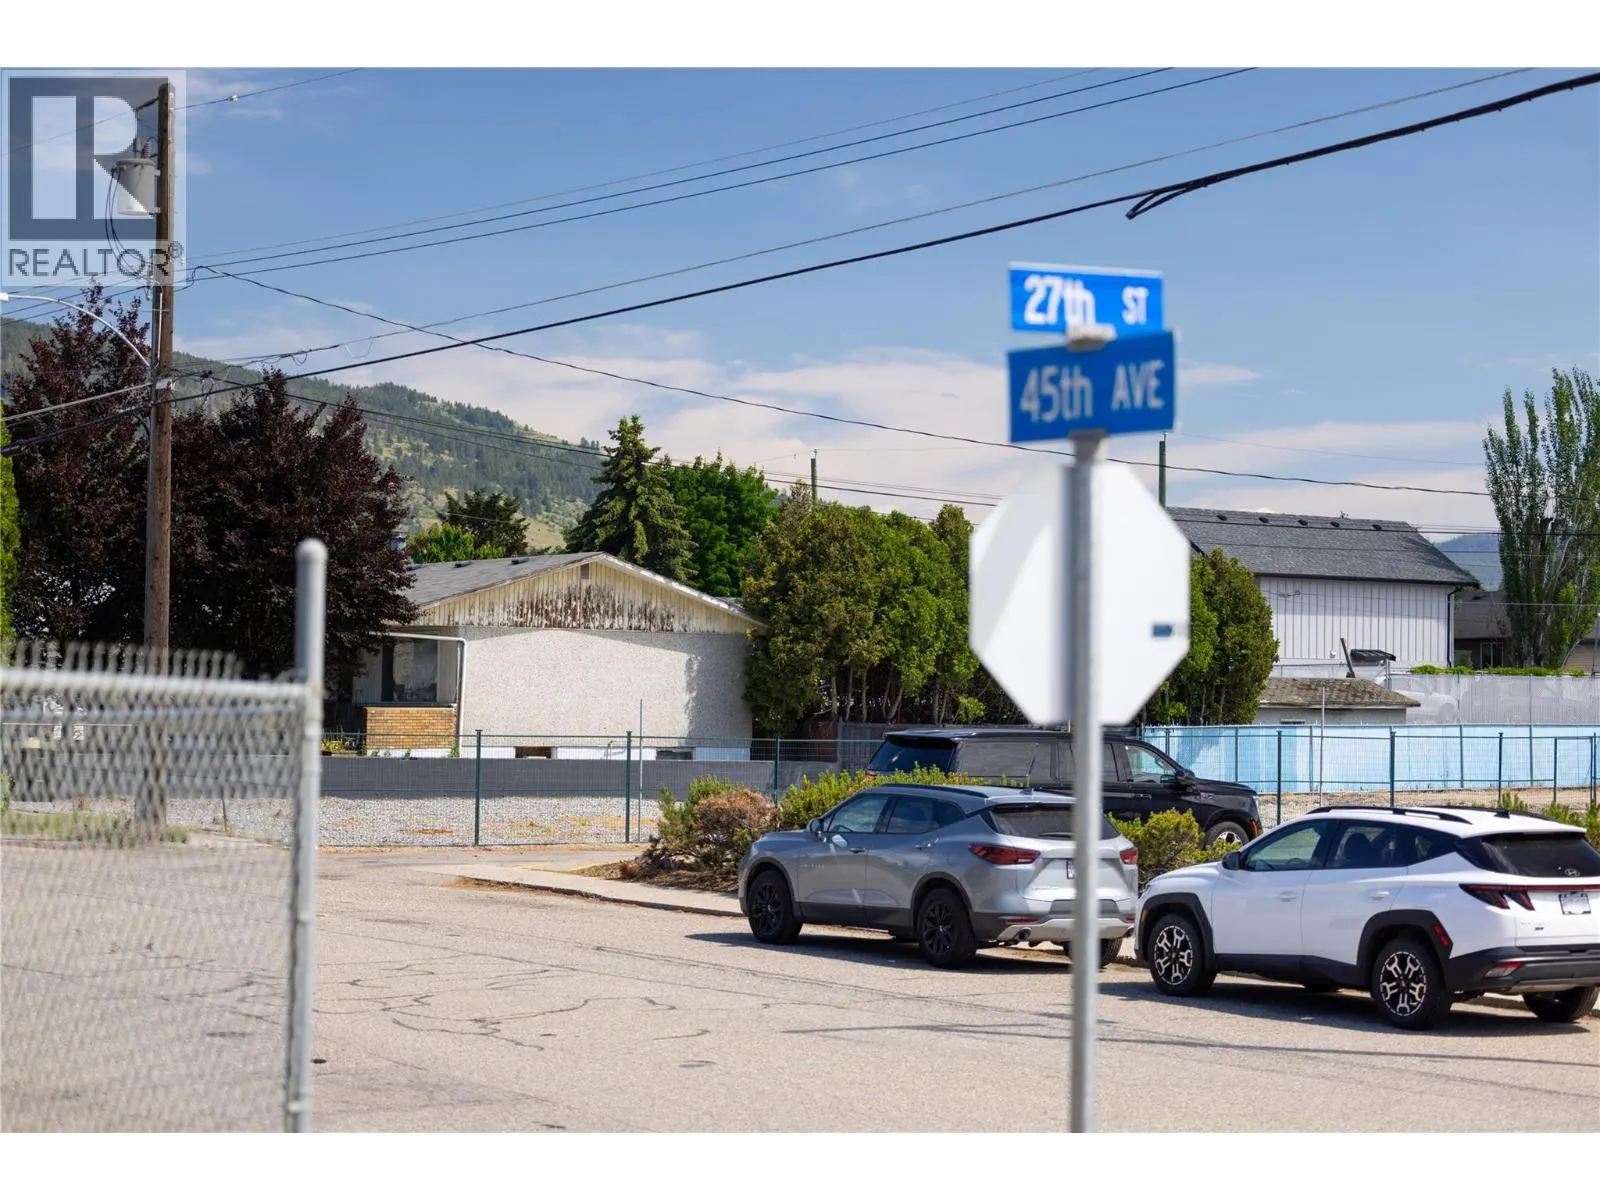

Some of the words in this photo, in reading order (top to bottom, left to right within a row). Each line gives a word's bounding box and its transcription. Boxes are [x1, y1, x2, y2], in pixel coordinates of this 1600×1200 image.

[1023, 274, 1097, 327] 27th
[1121, 285, 1150, 326] ST
[1019, 364, 1094, 424] 45th
[1111, 359, 1166, 412] AVE
